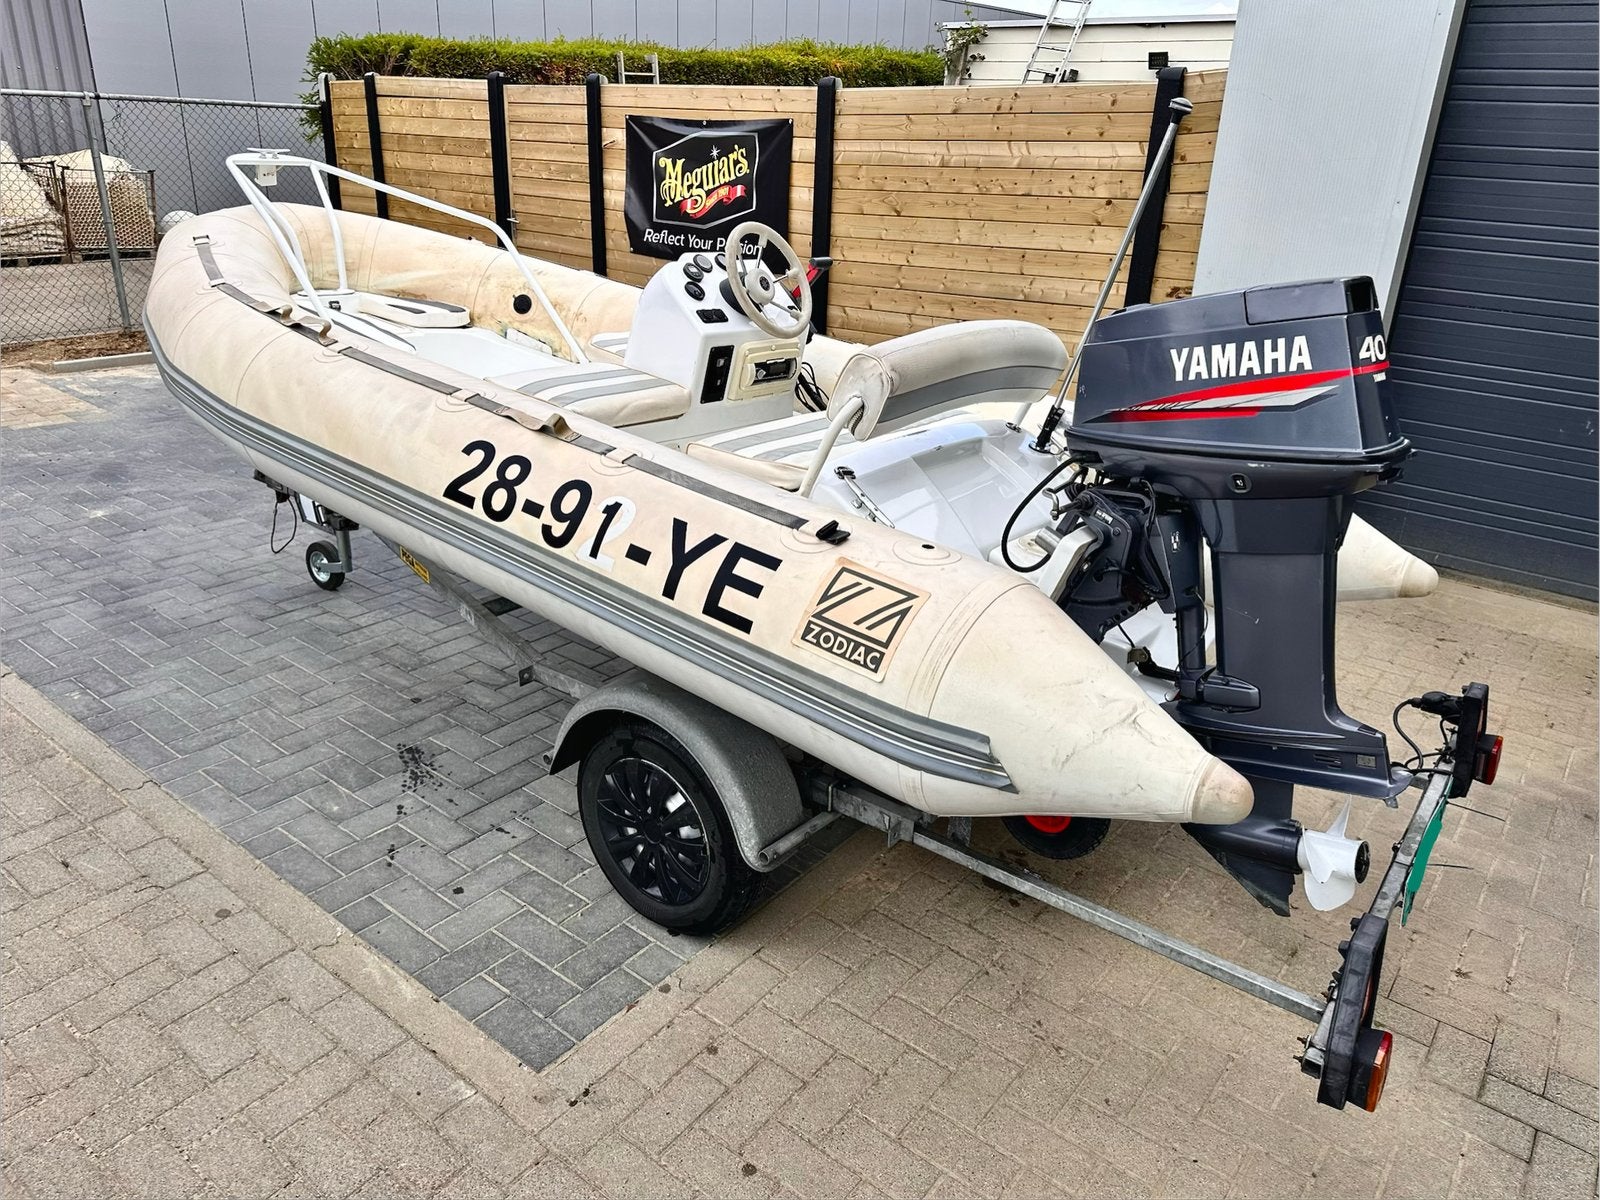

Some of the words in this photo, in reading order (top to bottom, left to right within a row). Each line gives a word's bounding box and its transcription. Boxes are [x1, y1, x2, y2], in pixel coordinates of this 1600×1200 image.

[643, 228, 686, 247] Reflect
[687, 233, 714, 251] Your
[1169, 334, 1314, 382] YAMAHA
[1358, 334, 1387, 363] 40
[804, 623, 881, 670] ZODIAC
